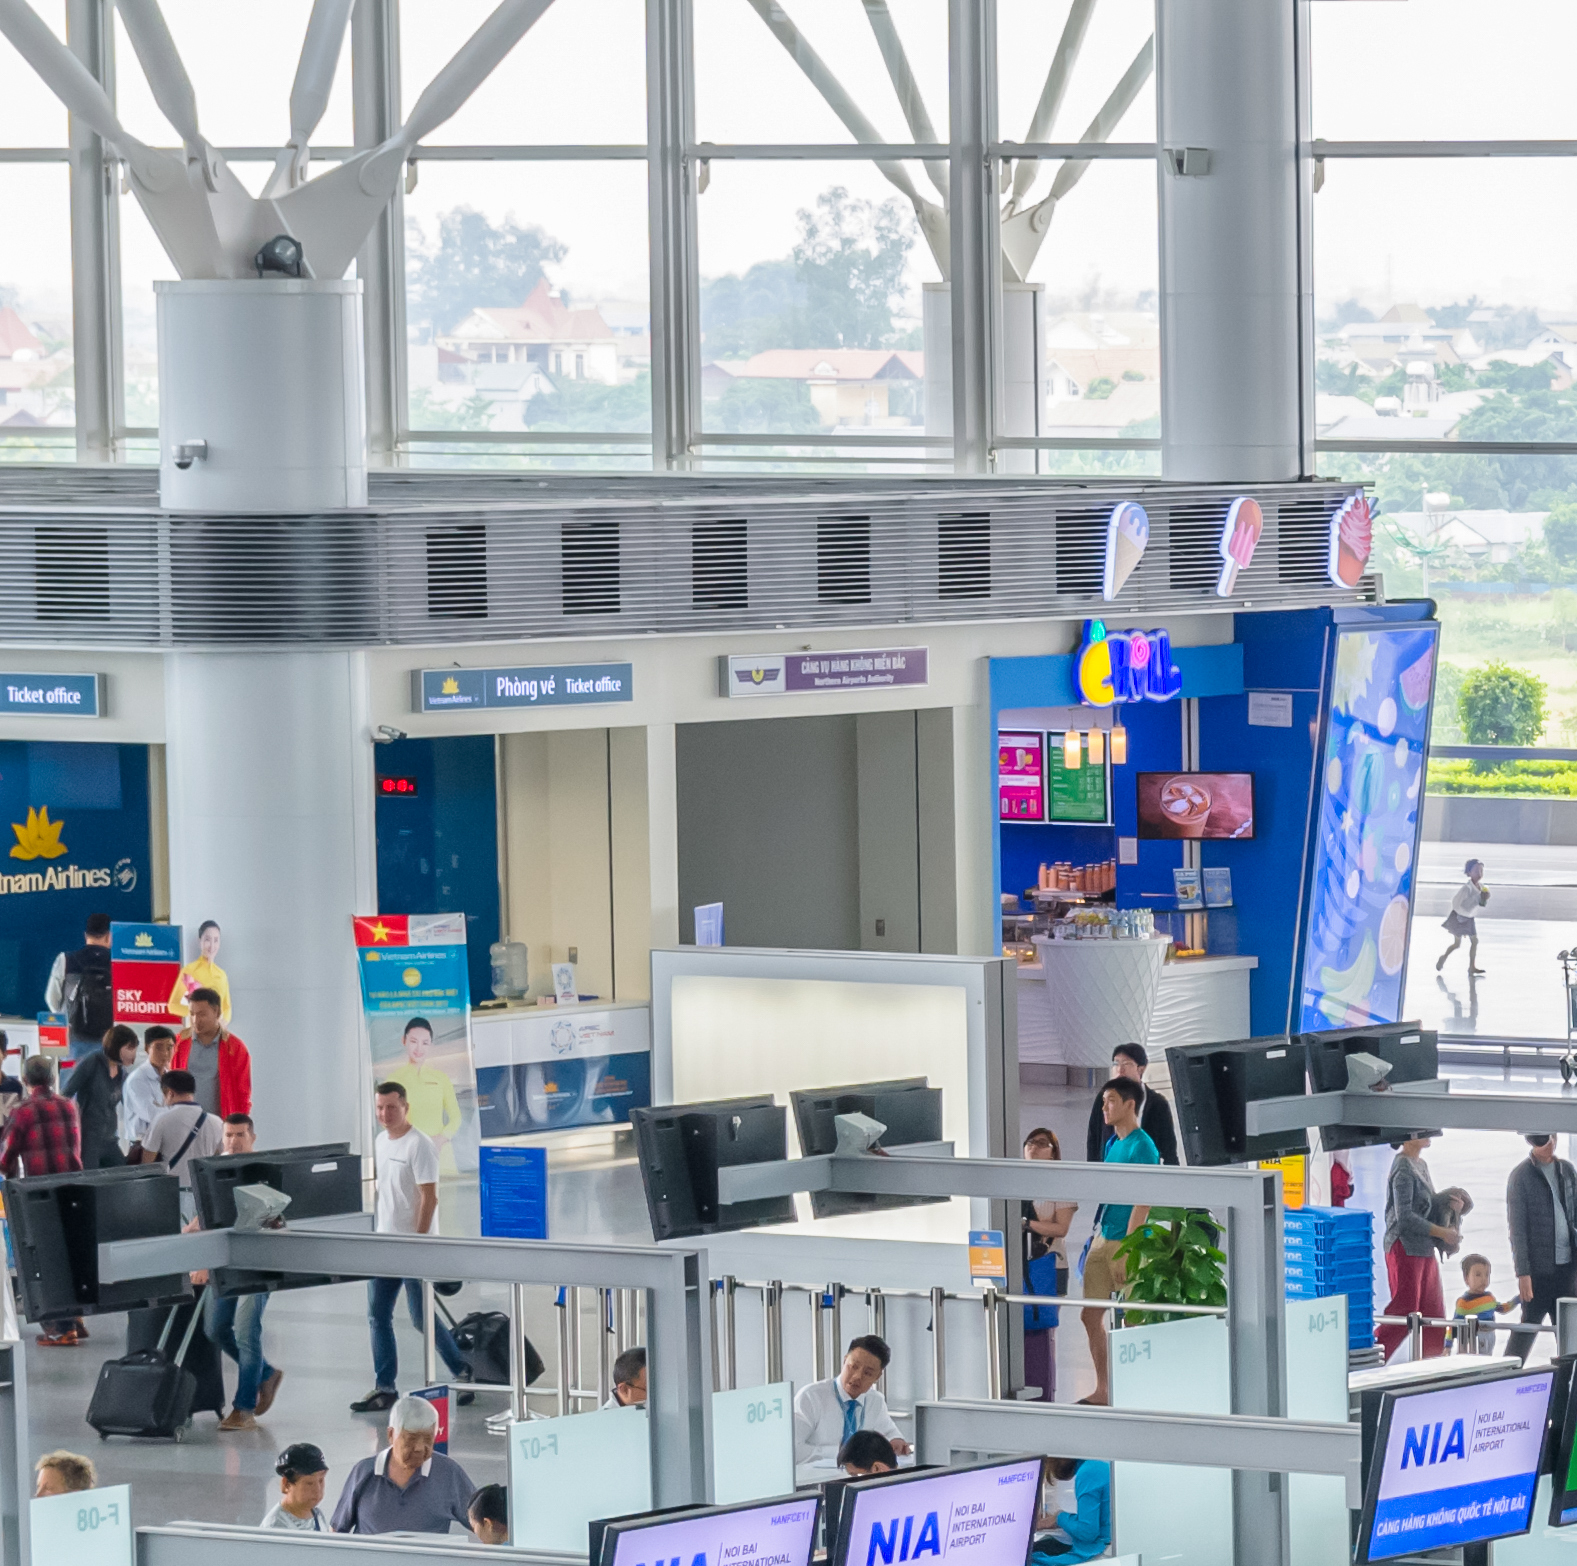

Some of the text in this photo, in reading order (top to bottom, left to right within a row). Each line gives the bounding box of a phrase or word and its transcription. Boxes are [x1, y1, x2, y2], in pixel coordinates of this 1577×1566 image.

[7, 686, 81, 704] Ticket office
[496, 675, 621, 700] Phòng vé Ticket office
[117, 990, 142, 1001] SKY
[117, 1002, 167, 1014] PRIORIT
[1478, 1411, 1505, 1424] NOI BAI
[1475, 1421, 1530, 1438] INTERNATIONAL
[1400, 1418, 1465, 1470] NIA
[1473, 1439, 1504, 1453] AIRPORT
[954, 1502, 986, 1516] NOI BAI
[952, 1512, 1016, 1532] INTERNATIONAL
[950, 1533, 986, 1549] AIRPORT
[724, 1543, 758, 1558] NOI BAI
